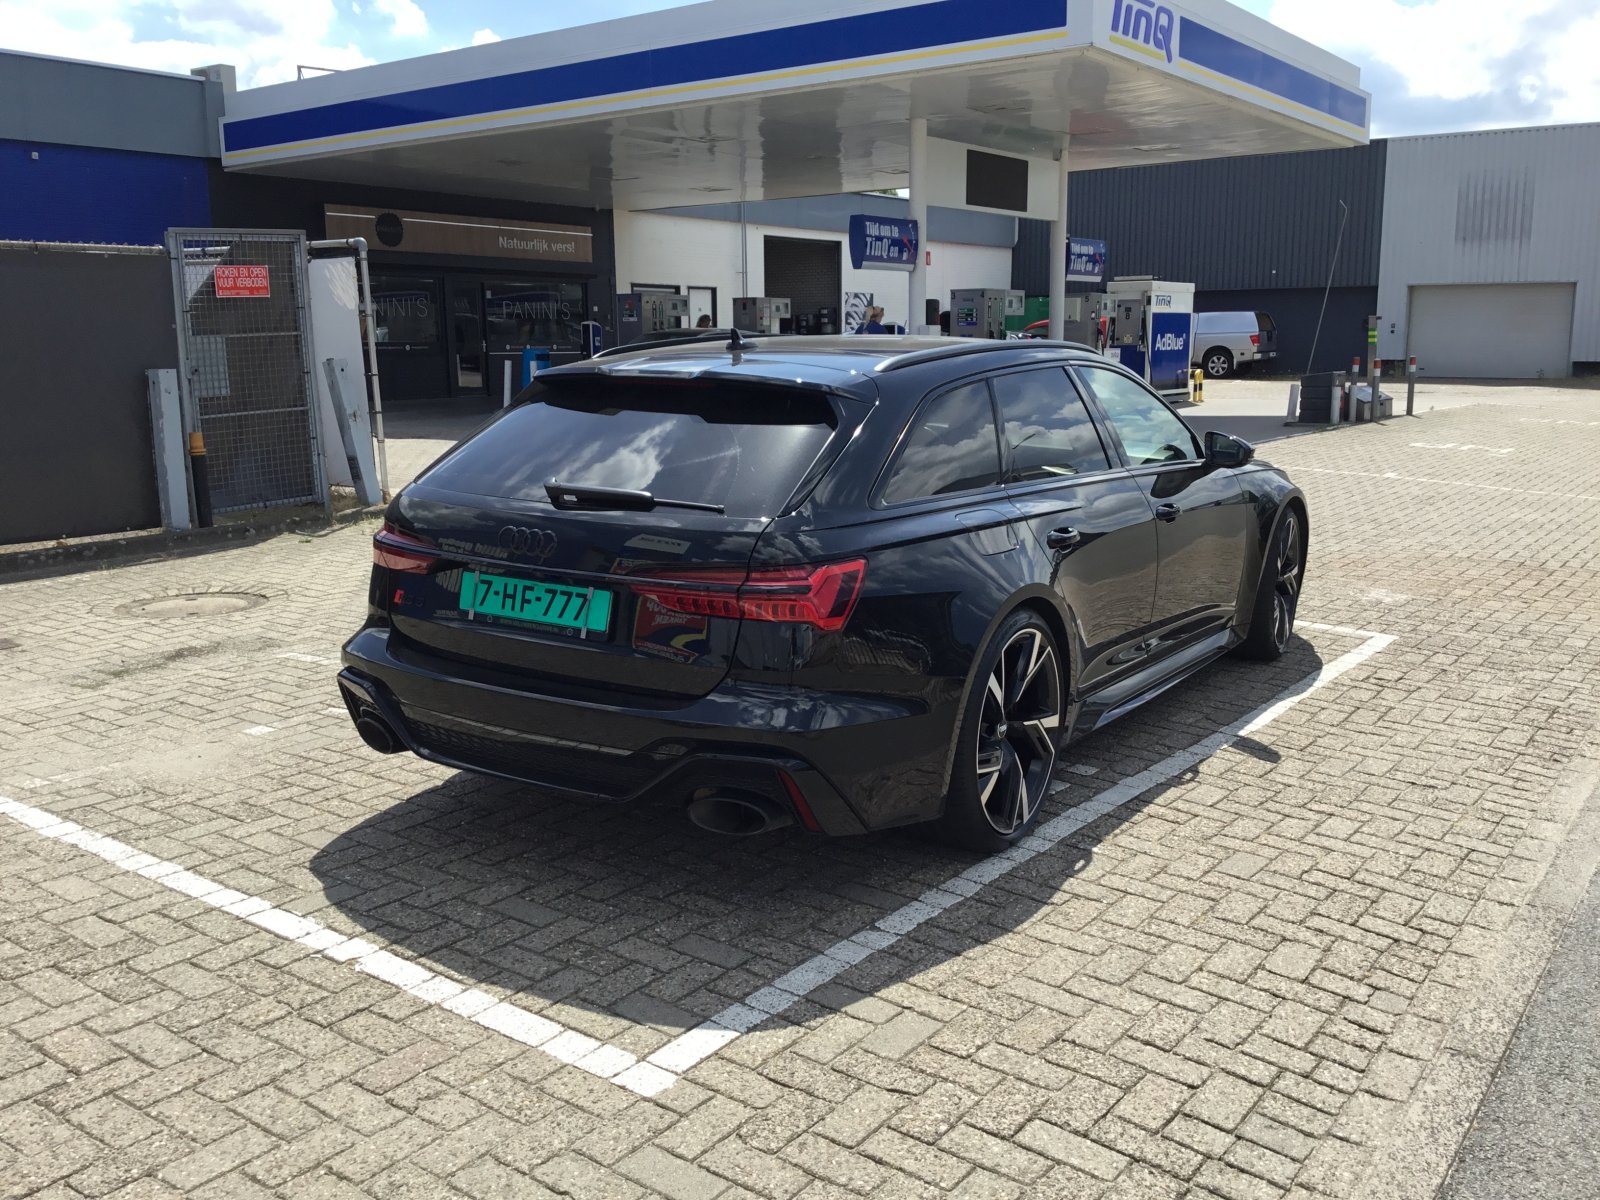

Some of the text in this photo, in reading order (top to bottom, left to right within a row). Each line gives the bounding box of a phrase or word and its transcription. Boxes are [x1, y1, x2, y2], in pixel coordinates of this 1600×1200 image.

[1111, 0, 1174, 64] TinQ
[866, 222, 899, 237] Tijd om te
[499, 236, 576, 254] Natuurlijk vers!
[216, 267, 267, 278] ROKEN EN OPEN
[217, 278, 268, 288] VUUR VERBODEN
[371, 297, 428, 318] NINI'S
[1155, 294, 1172, 308] TinQ
[479, 579, 590, 621] 7-HF-777
